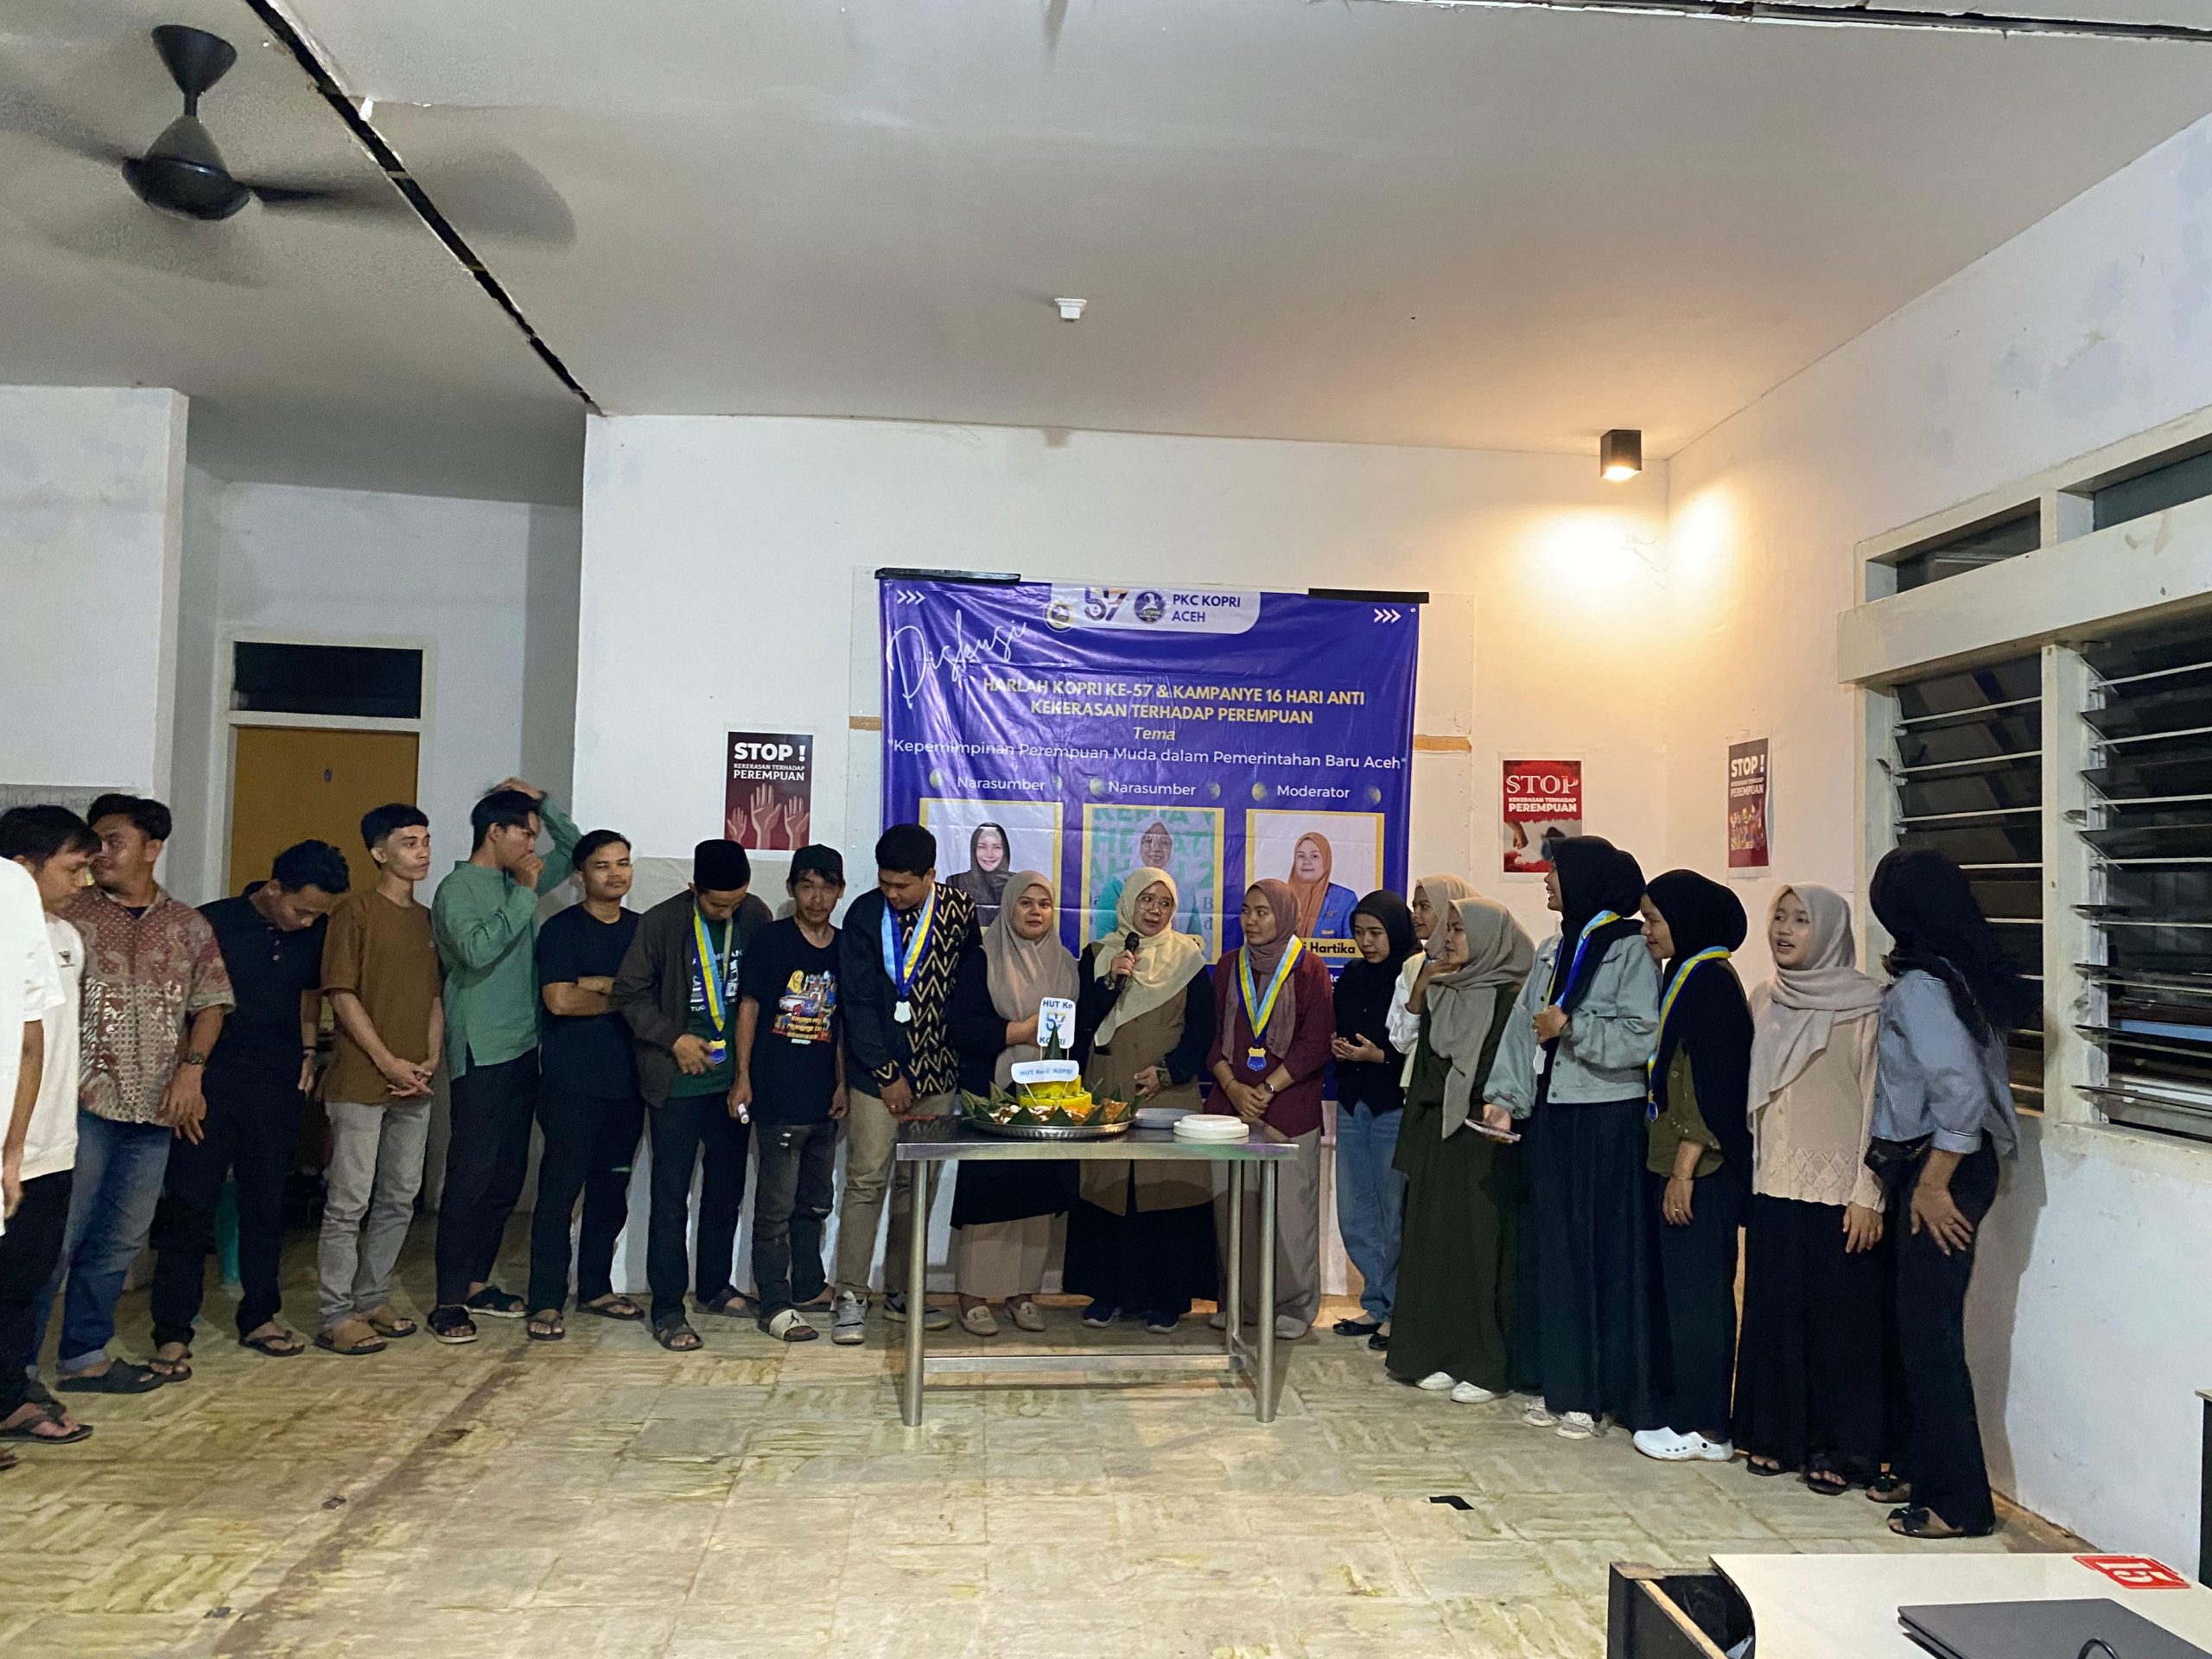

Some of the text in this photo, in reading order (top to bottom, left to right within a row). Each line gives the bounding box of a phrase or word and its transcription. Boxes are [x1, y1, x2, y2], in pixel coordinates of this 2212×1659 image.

[1173, 594, 1241, 607] PKC KOPRI
[1172, 610, 1205, 623] ACEH
[982, 677, 1365, 705] HARLAH KOPRI KE-57 & KAMPANYE 16 HARI ANTI
[1031, 700, 1313, 724] KEKERASAN TERHADAP PEREMPUAN
[1133, 727, 1176, 741] Tema
[734, 741, 806, 762] STOP !
[1020, 744, 1109, 761] Perempuan
[1113, 747, 1157, 761] Muda
[1160, 748, 1209, 763] dalam
[1213, 751, 1321, 767] Pemerintahan
[1325, 754, 1360, 768] Baru
[1363, 756, 1407, 769] Aceh"
[1731, 755, 1758, 778] STOP
[734, 770, 804, 780] PEREMPUAN
[957, 777, 1046, 791] Narasumber
[1109, 781, 1197, 796] Narasumber
[1505, 774, 1579, 794] STOP
[1277, 785, 1351, 798] Moderator
[1509, 804, 1577, 812] PEREMPUAN
[1310, 942, 1356, 954] Hartika
